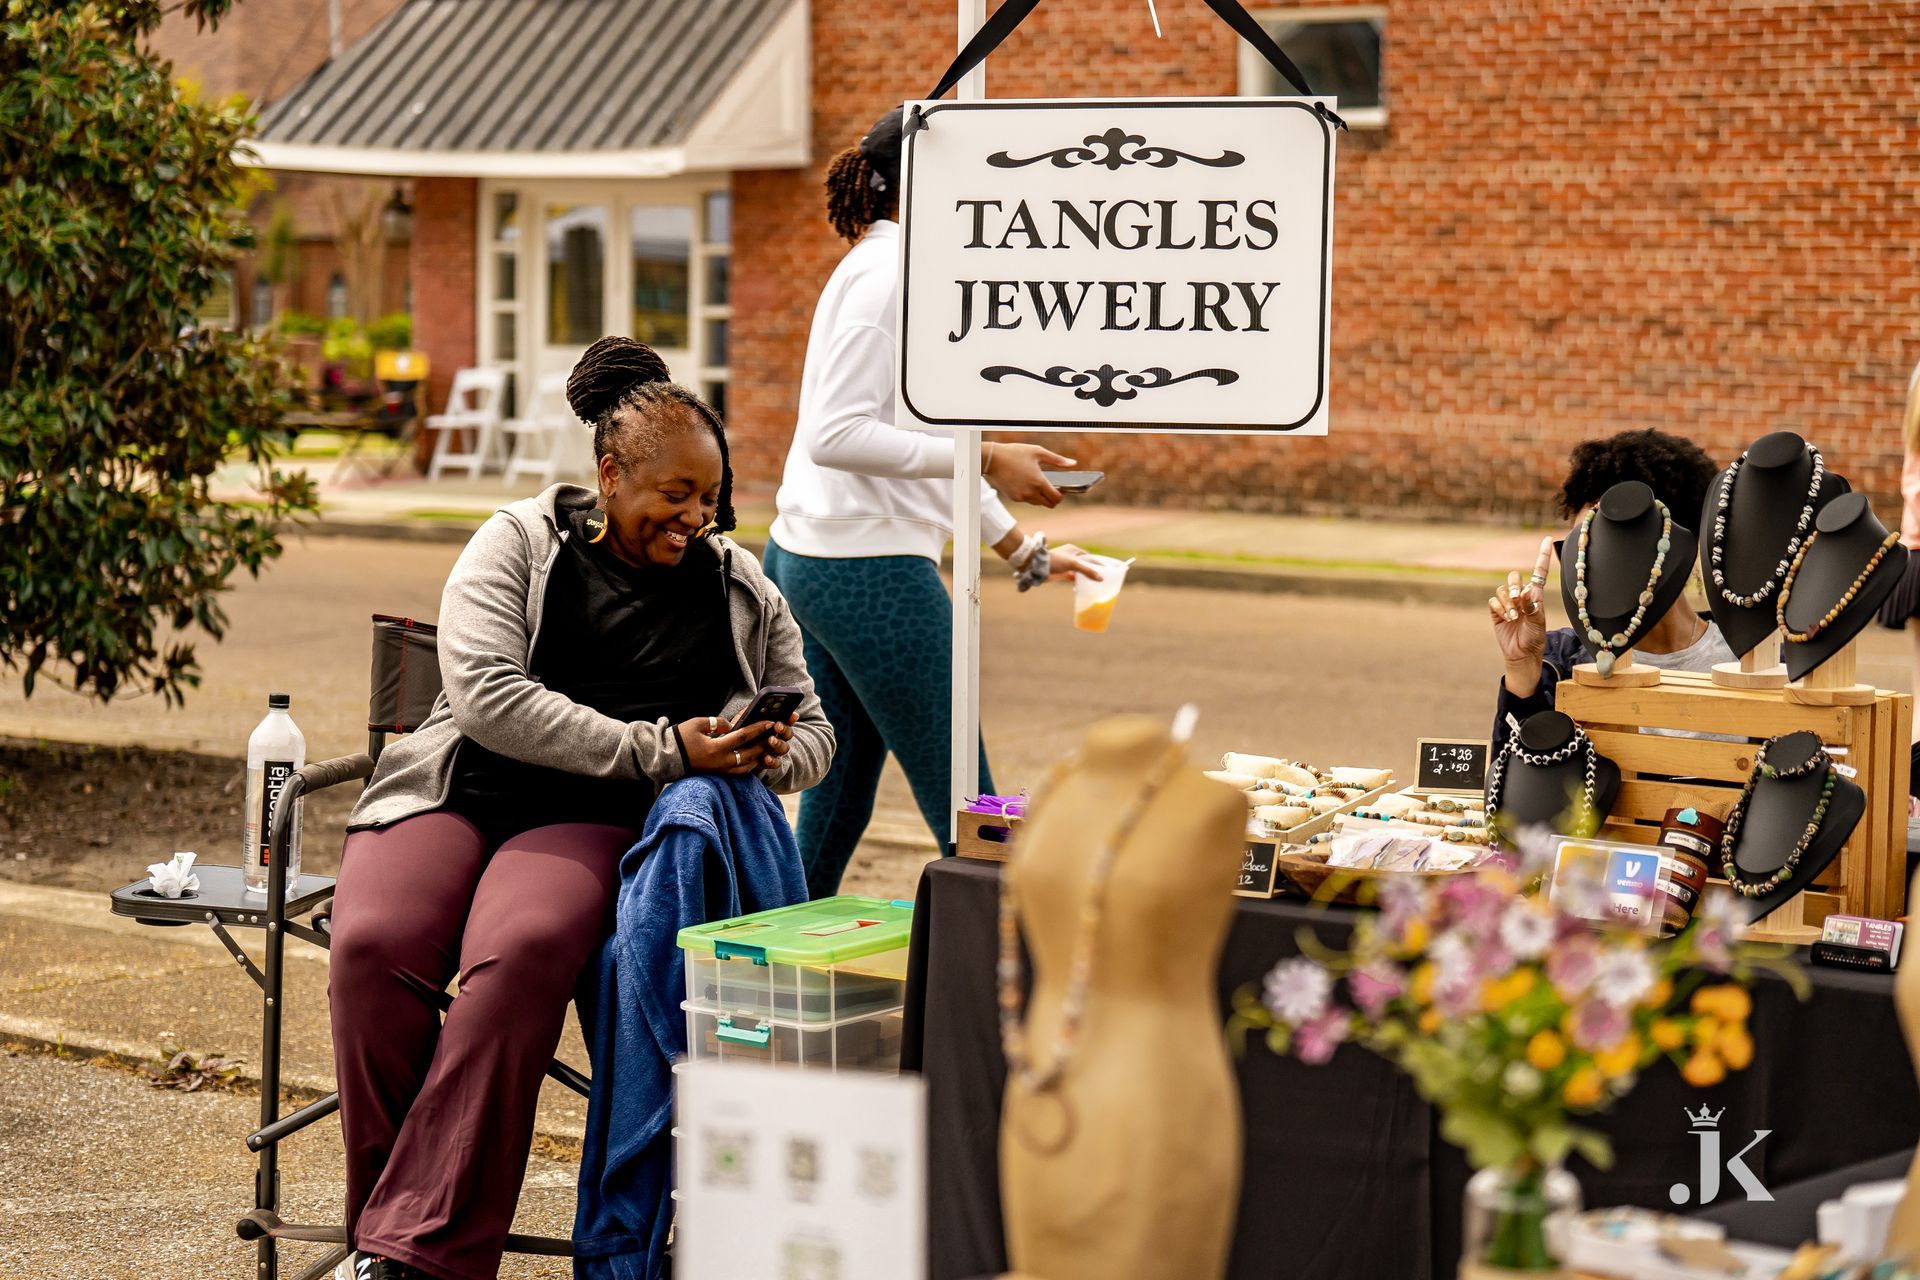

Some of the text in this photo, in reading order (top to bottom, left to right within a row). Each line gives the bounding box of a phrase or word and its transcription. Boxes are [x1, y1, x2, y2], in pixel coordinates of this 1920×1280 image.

[955, 199, 1279, 250] TANGLES
[948, 280, 1281, 343] JEWELRY
[1614, 904, 1639, 915] Here
